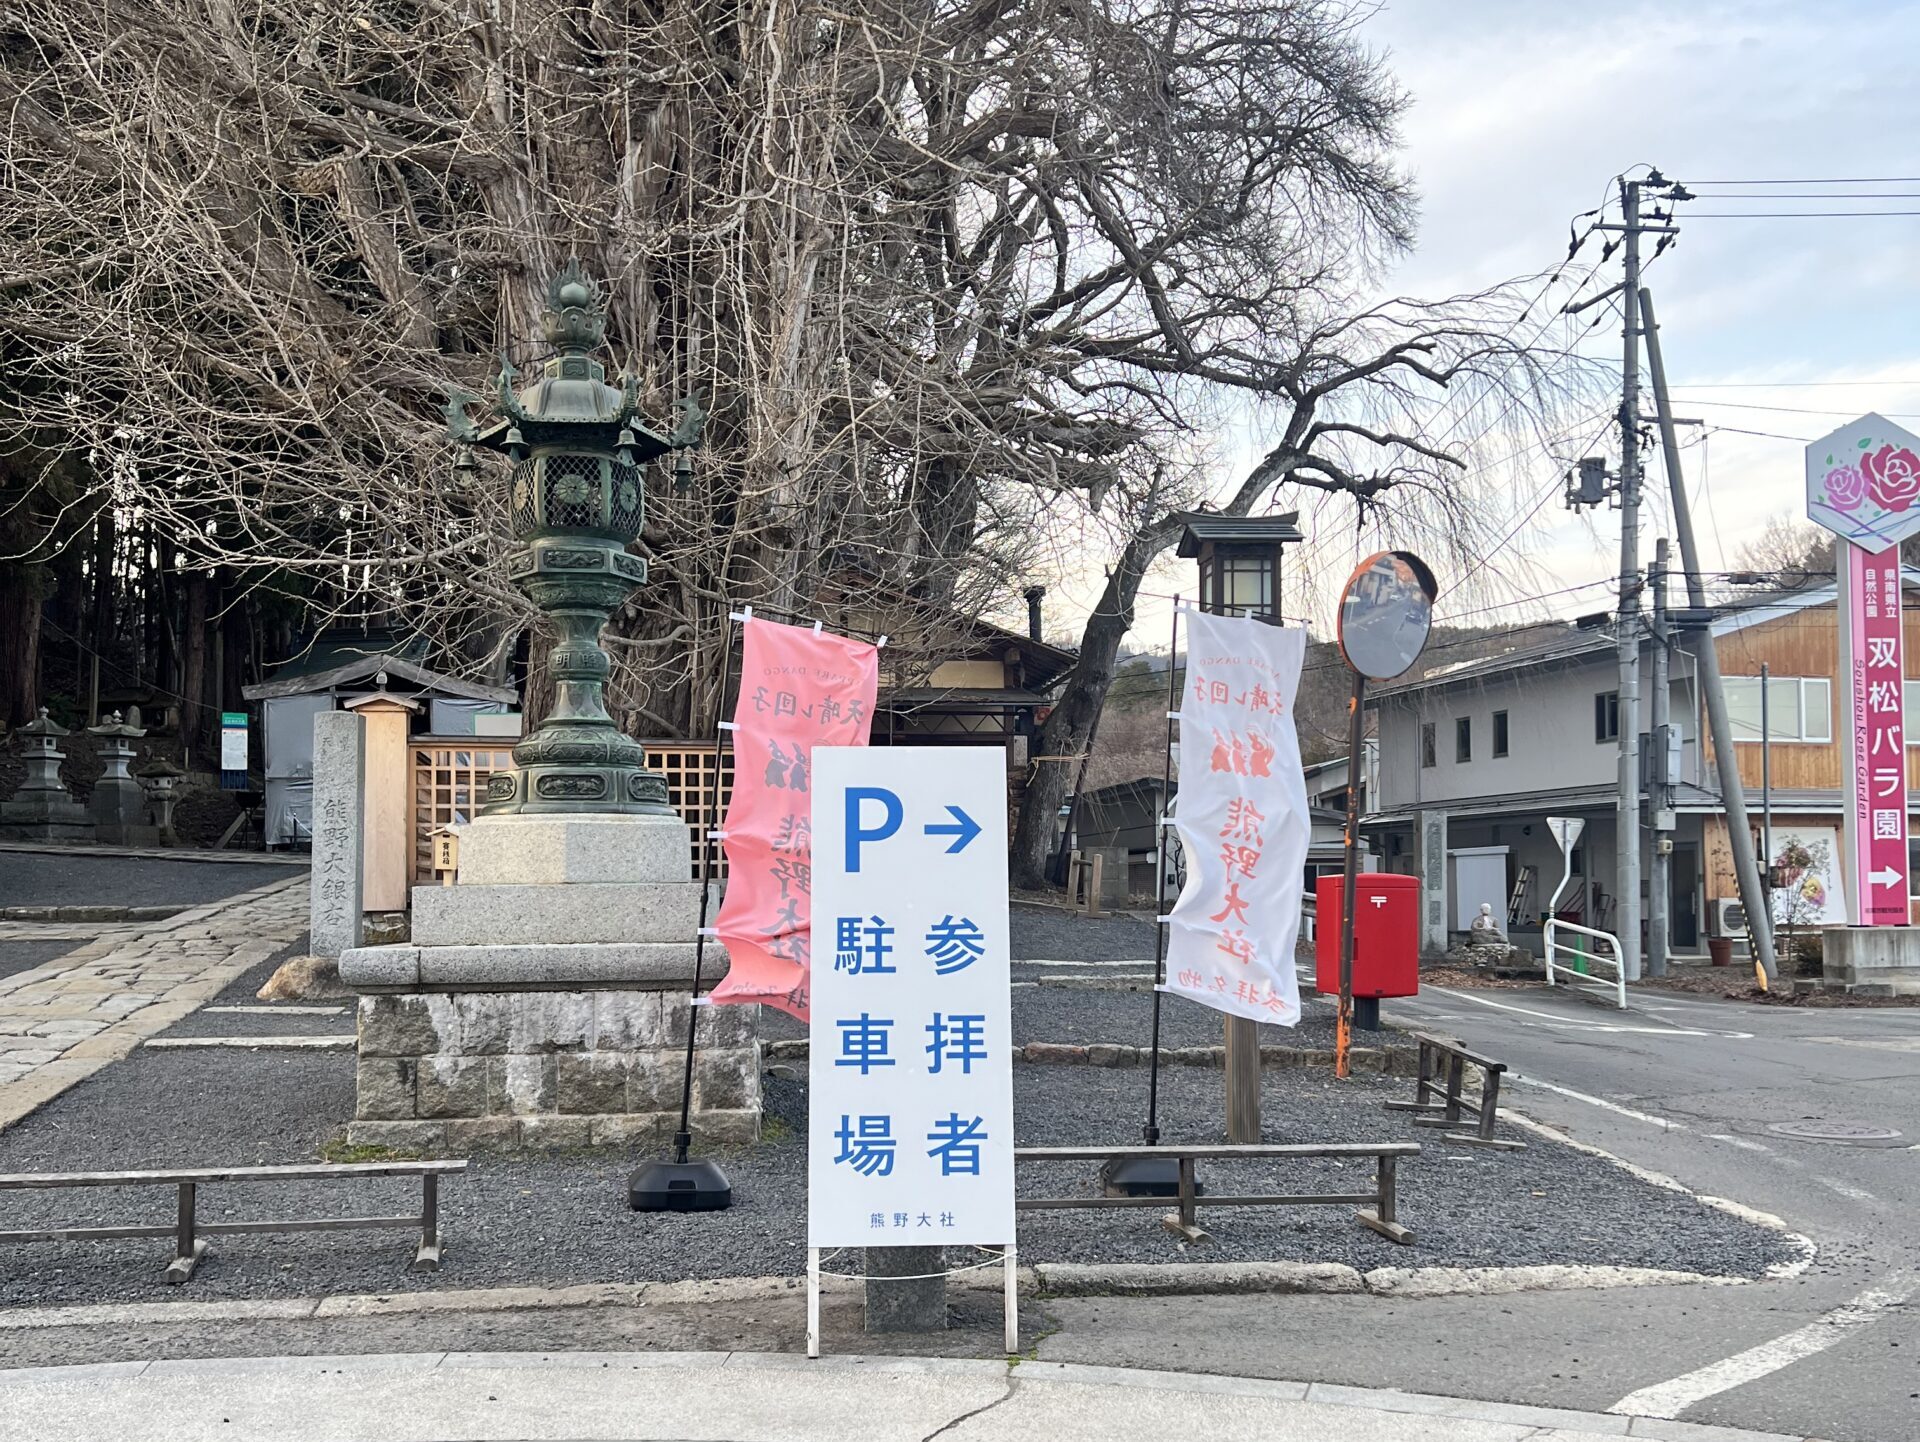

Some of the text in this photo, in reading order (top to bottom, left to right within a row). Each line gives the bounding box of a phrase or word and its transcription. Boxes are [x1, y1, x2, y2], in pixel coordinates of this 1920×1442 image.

[1865, 568, 1878, 617] 自然公園
[1856, 725, 1867, 762] Rose
[1867, 637, 1902, 841] 双松バラ園
[1858, 766, 1869, 819] Garden
[845, 787, 904, 872] P
[834, 915, 897, 1177] 駐車場
[924, 914, 988, 1176] 参拝者
[870, 1212, 955, 1228] 熊野大社
